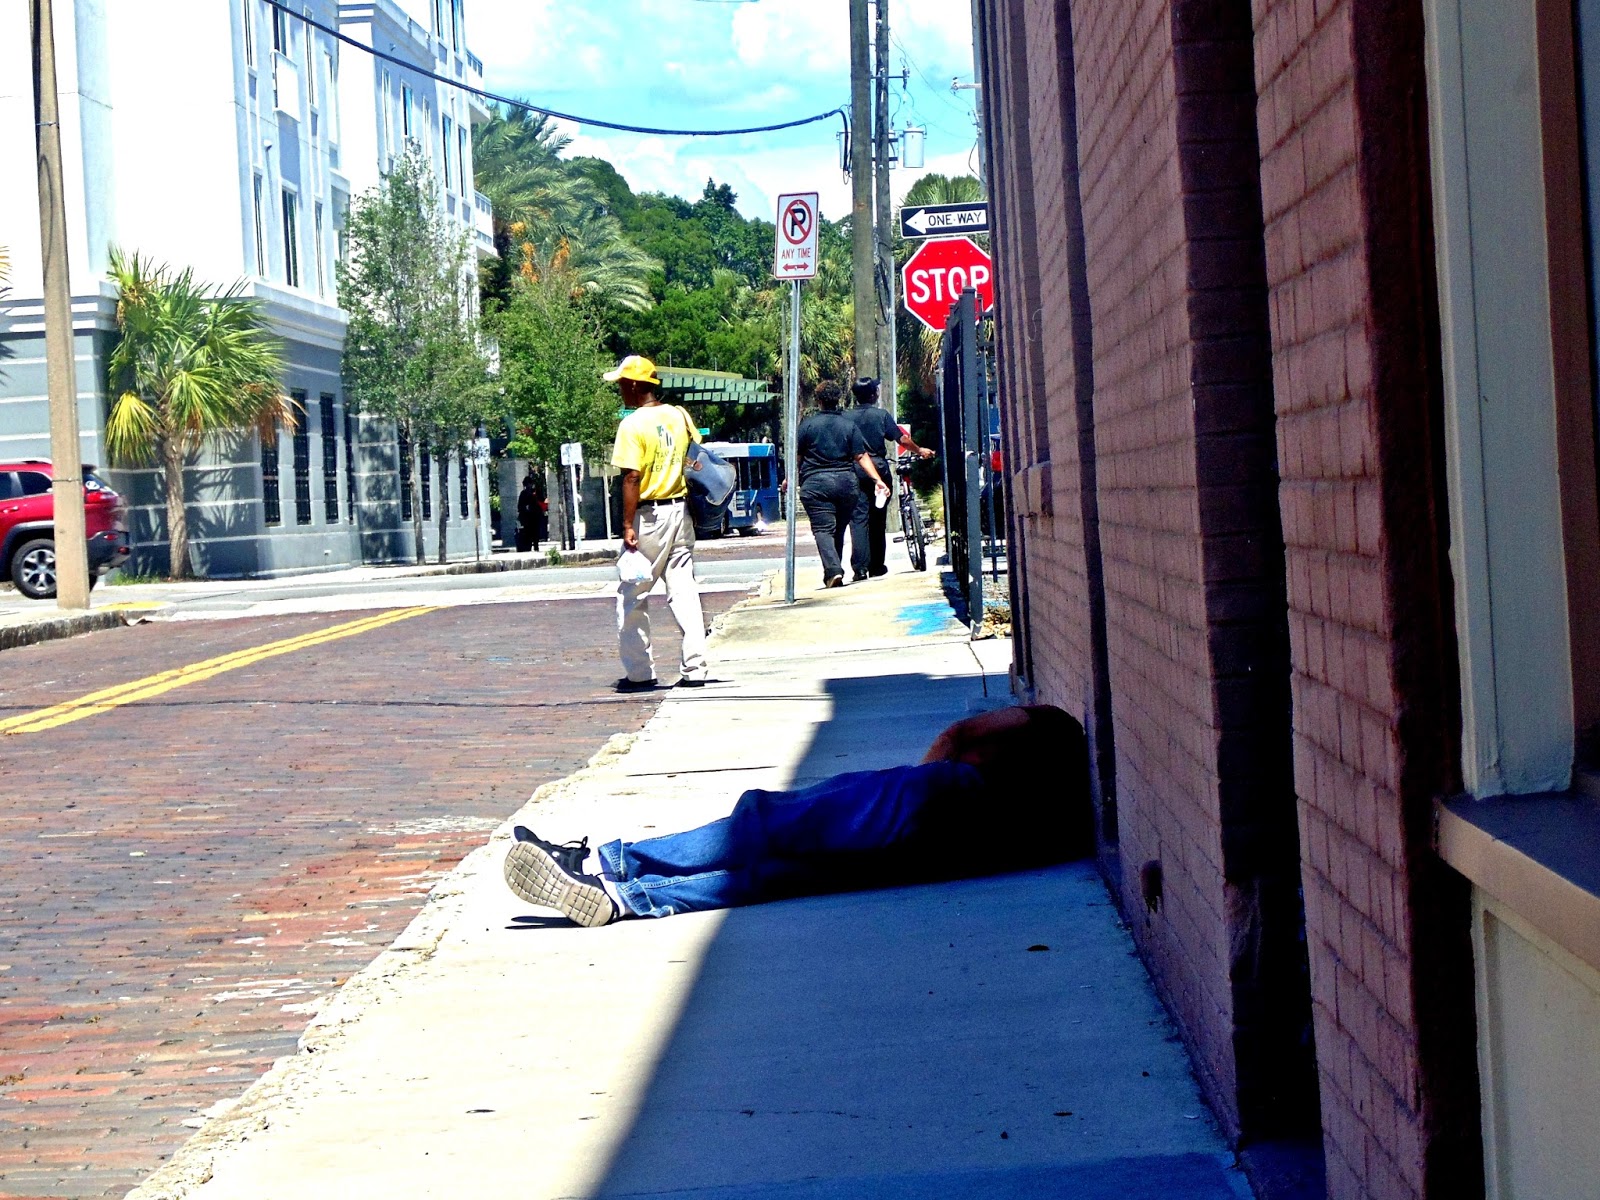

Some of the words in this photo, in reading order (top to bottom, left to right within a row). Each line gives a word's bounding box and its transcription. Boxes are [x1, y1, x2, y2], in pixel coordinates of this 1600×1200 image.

[928, 213, 954, 226] ONE
[958, 211, 983, 224] WAY
[781, 248, 795, 259] ANY
[797, 247, 811, 259] TIME
[911, 265, 989, 304] STOP
